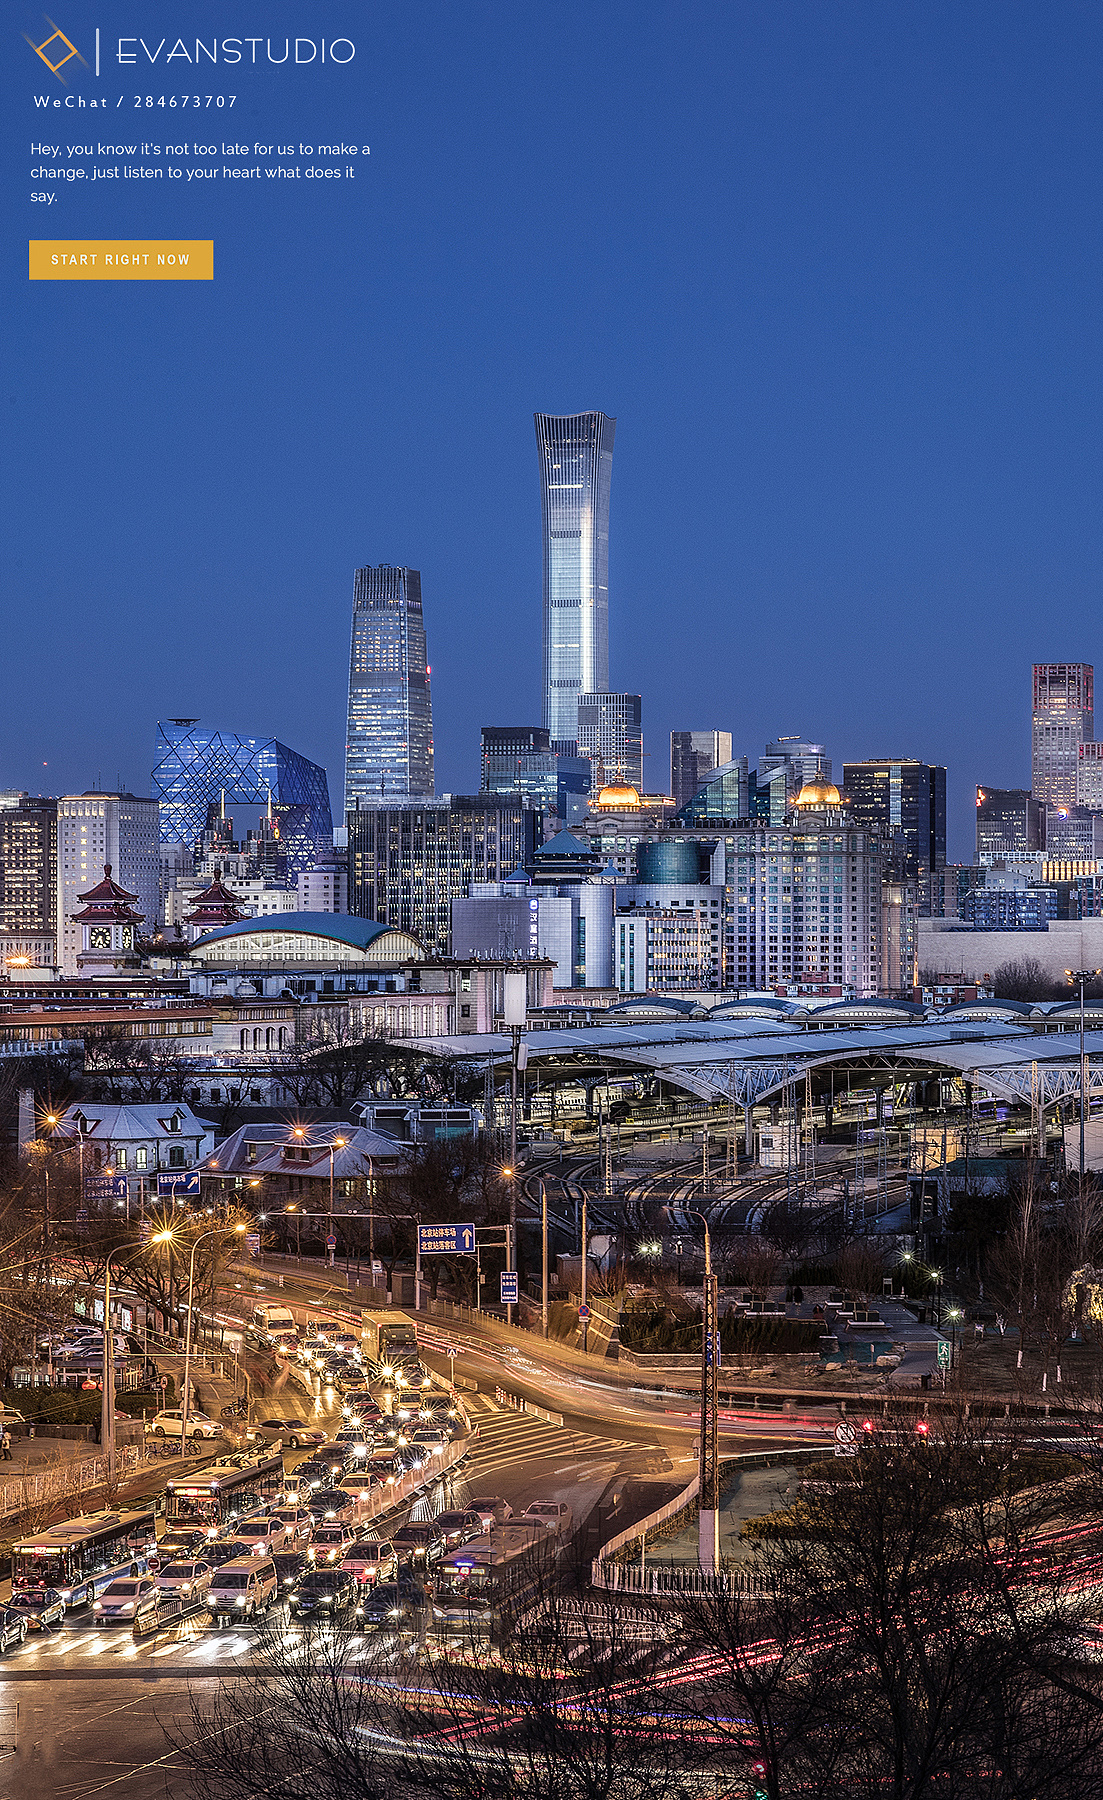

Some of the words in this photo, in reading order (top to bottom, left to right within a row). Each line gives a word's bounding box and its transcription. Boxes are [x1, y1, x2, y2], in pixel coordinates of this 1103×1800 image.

[421, 1228, 456, 1237] 北京站停车场
[421, 1241, 456, 1250] 北京站落客区
